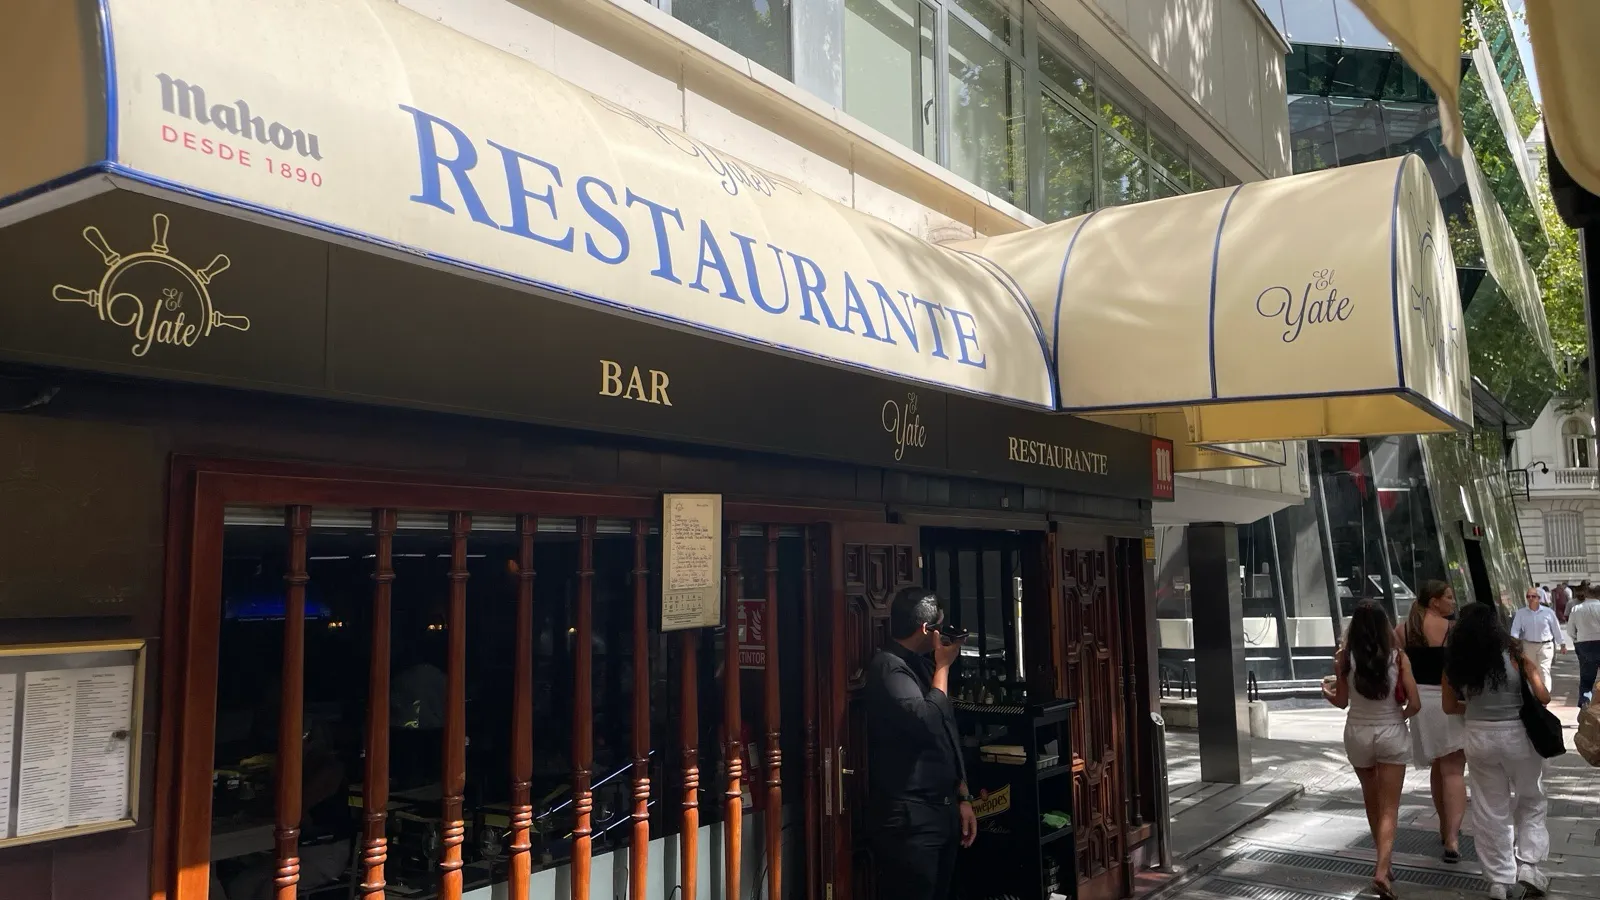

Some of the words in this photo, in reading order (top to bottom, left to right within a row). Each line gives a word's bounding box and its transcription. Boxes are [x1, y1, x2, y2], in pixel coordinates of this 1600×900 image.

[161, 124, 252, 168] DESDE
[265, 157, 323, 187] 1890
[398, 103, 988, 370] RESTAURANTE
[162, 287, 184, 311] El
[1312, 268, 1335, 291] El
[107, 292, 198, 357] Yate
[1256, 282, 1355, 343] Yate
[599, 359, 672, 406] BAR
[907, 392, 918, 414] El
[881, 399, 927, 461] Yate
[1007, 435, 1108, 477] RESTAURANTE
